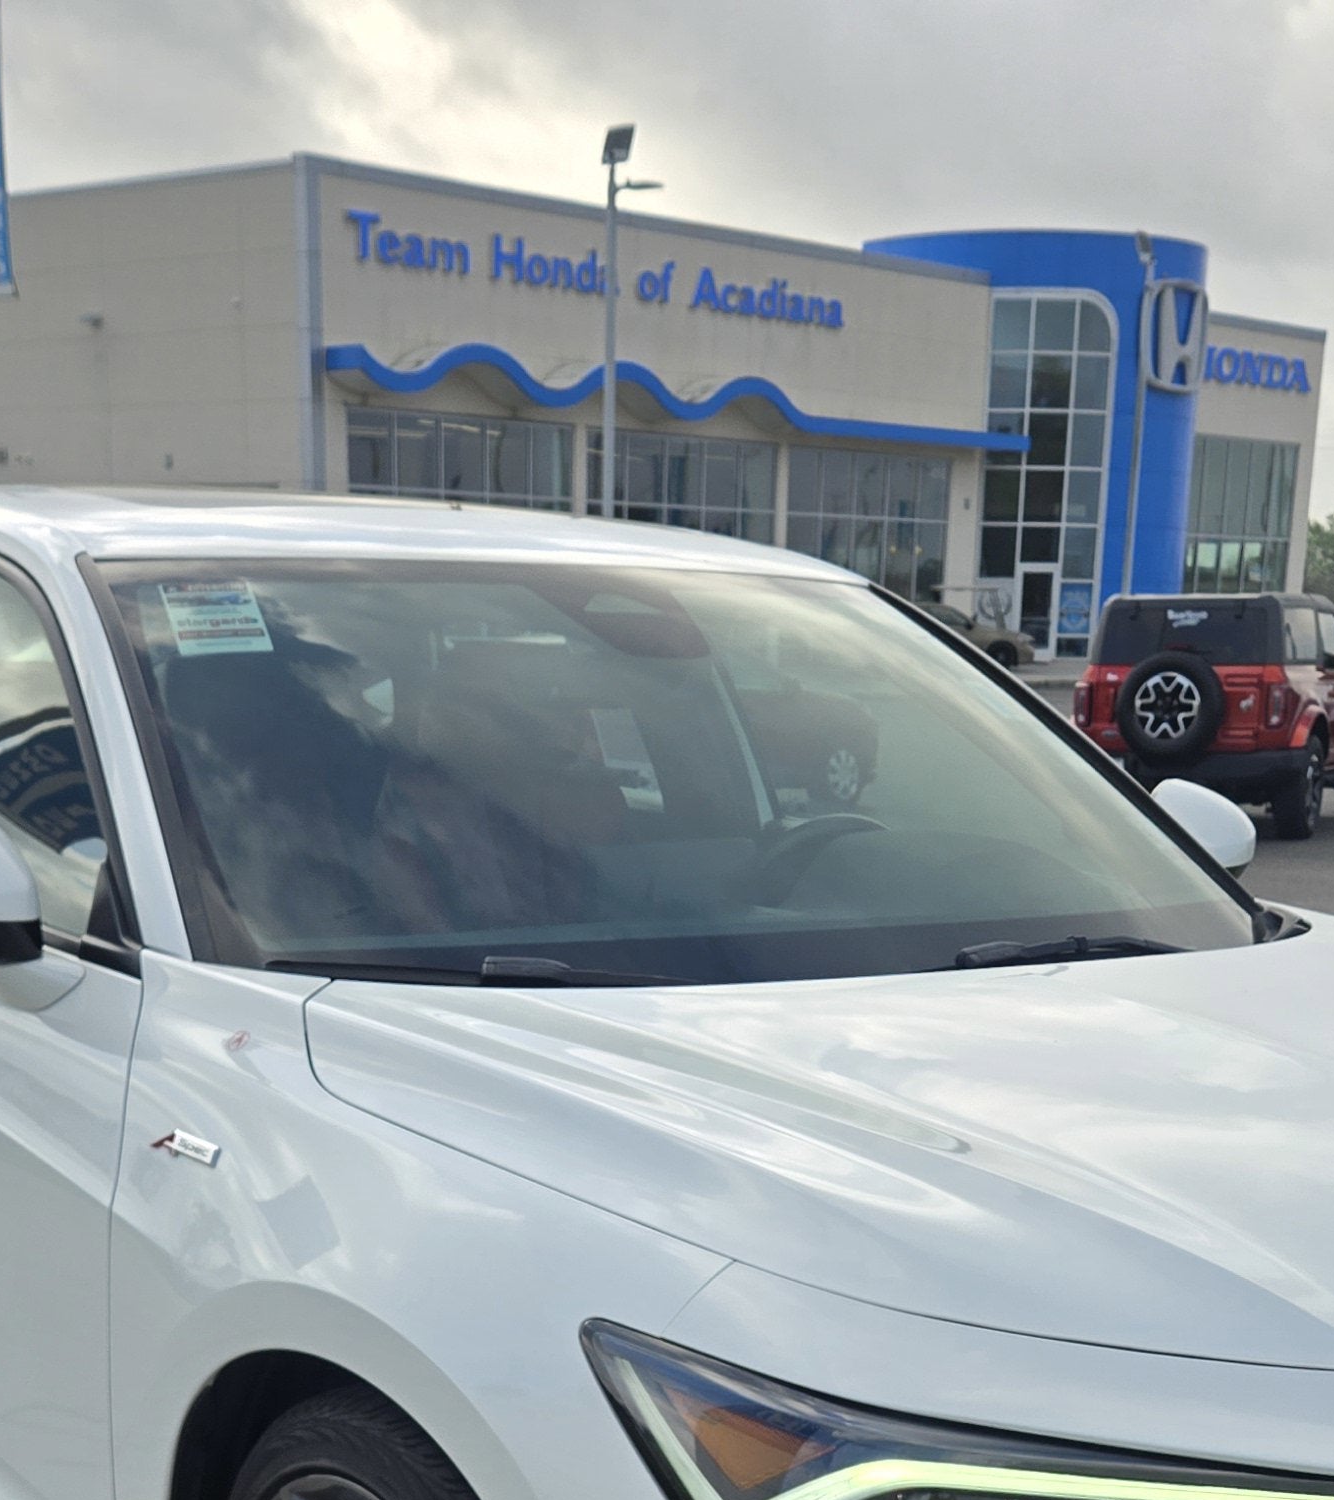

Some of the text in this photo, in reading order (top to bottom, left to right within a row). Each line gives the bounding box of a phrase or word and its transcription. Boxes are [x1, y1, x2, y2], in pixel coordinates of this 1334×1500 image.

[346, 208, 471, 276] Team
[637, 260, 676, 304] of
[688, 266, 845, 330] Acadiana
